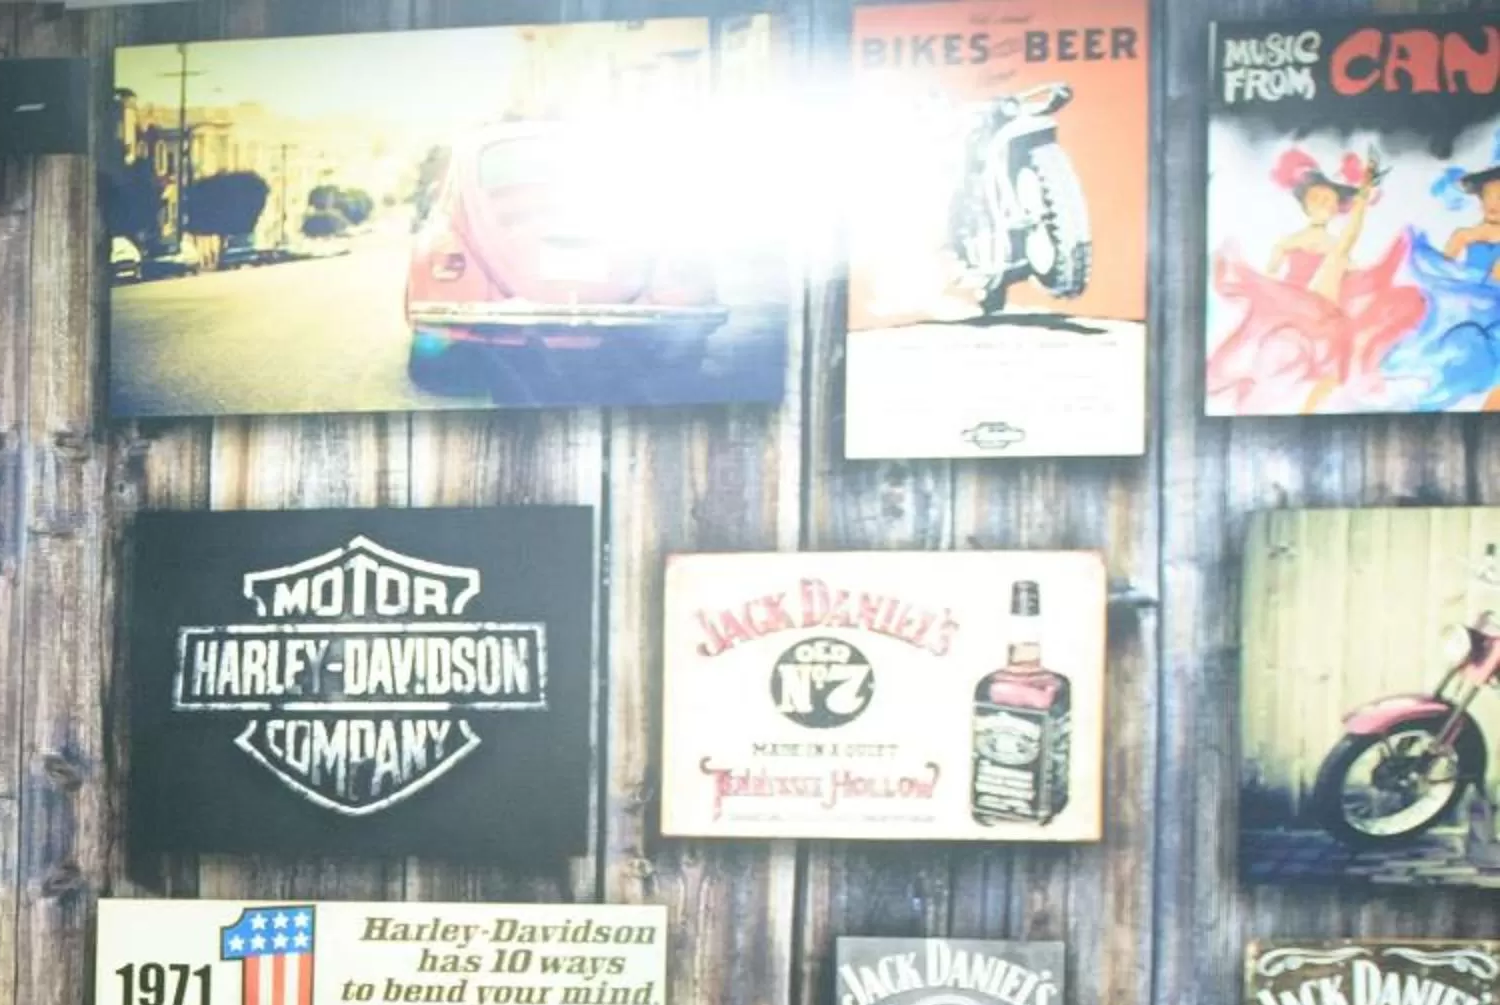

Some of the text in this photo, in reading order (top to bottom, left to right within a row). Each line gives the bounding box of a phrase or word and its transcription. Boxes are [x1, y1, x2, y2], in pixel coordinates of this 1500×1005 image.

[861, 33, 990, 68] BIKES
[1024, 27, 1138, 63] BEER
[1224, 30, 1321, 67] MUSIC
[1224, 66, 1315, 104] FROM
[272, 553, 449, 616] MOTOR
[695, 591, 797, 657] JACK
[193, 637, 529, 696] HARLEY-DAVIDSON
[265, 719, 451, 798] COMPANY
[358, 916, 658, 949] Harley-Davidson
[416, 948, 627, 981] has 10 ways
[340, 978, 375, 1003] to
[382, 977, 469, 1004] bend
